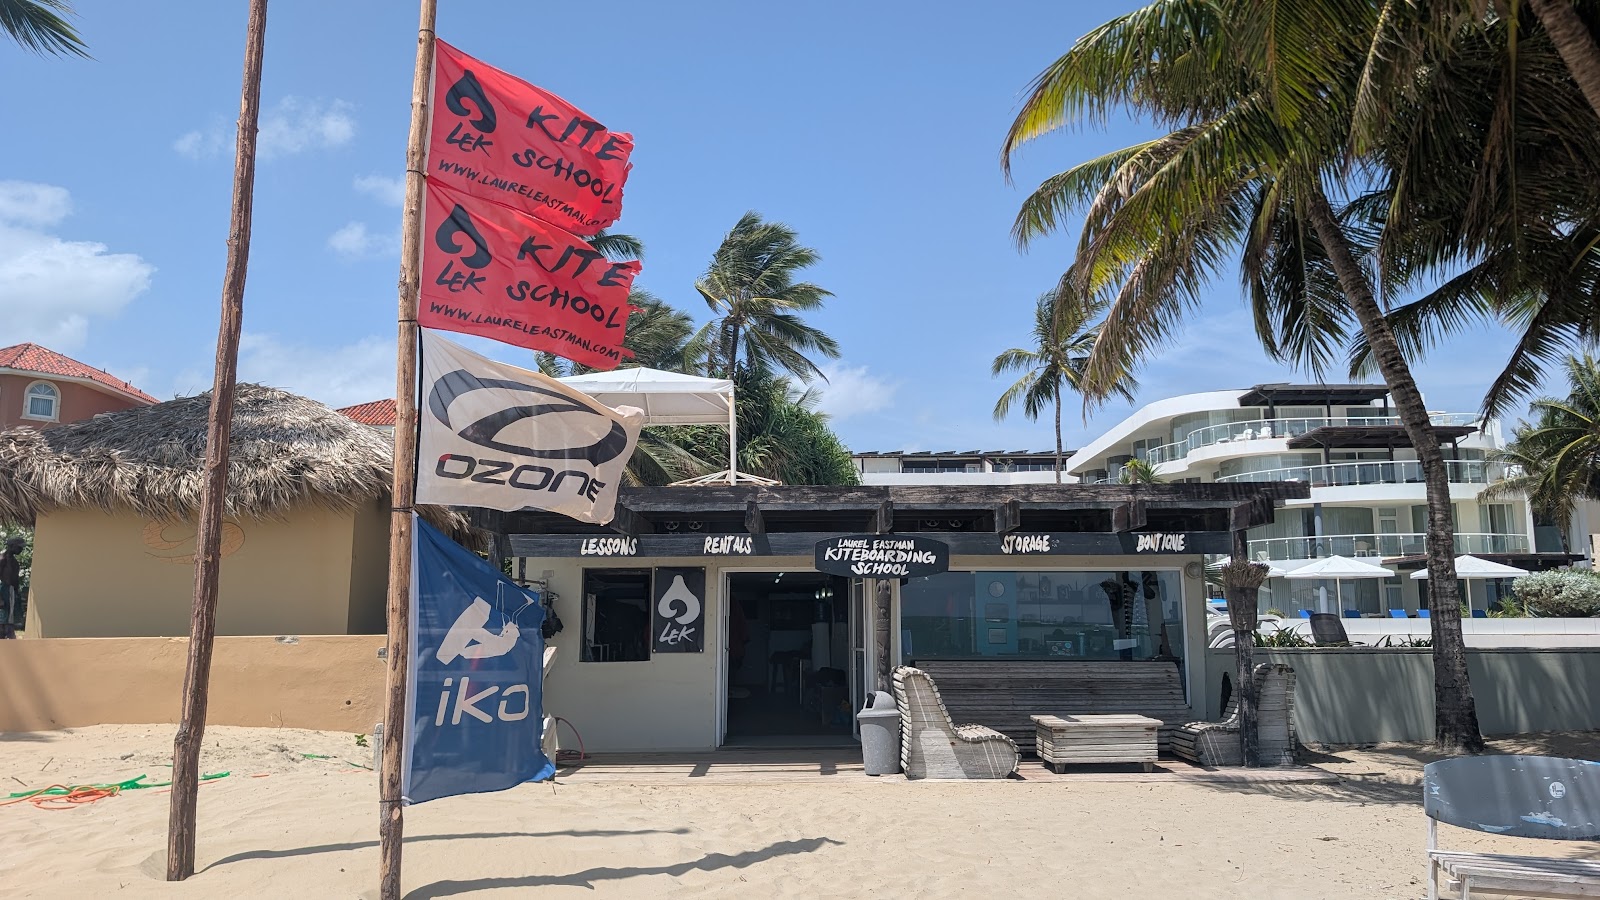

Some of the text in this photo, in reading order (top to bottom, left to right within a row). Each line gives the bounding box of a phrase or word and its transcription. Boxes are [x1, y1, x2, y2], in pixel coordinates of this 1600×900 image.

[445, 122, 494, 159] LEK
[525, 105, 630, 161] KITE
[512, 148, 615, 204] SCHOOL
[516, 236, 633, 287] KITE
[435, 260, 486, 295] LEK
[505, 280, 621, 329] SCHOOL
[430, 301, 621, 361] WWW.LAURELEASTMAN.COM
[580, 535, 638, 556] LESSONS
[703, 535, 753, 555] RENTALS
[837, 538, 915, 550] LAUREL EASTMAN
[1001, 534, 1051, 554] STORAGE
[1136, 533, 1186, 553] BOUTIQUE
[824, 547, 937, 565] KITEBOARDING
[851, 561, 910, 576] SCHOOL
[658, 621, 696, 646] LEK
